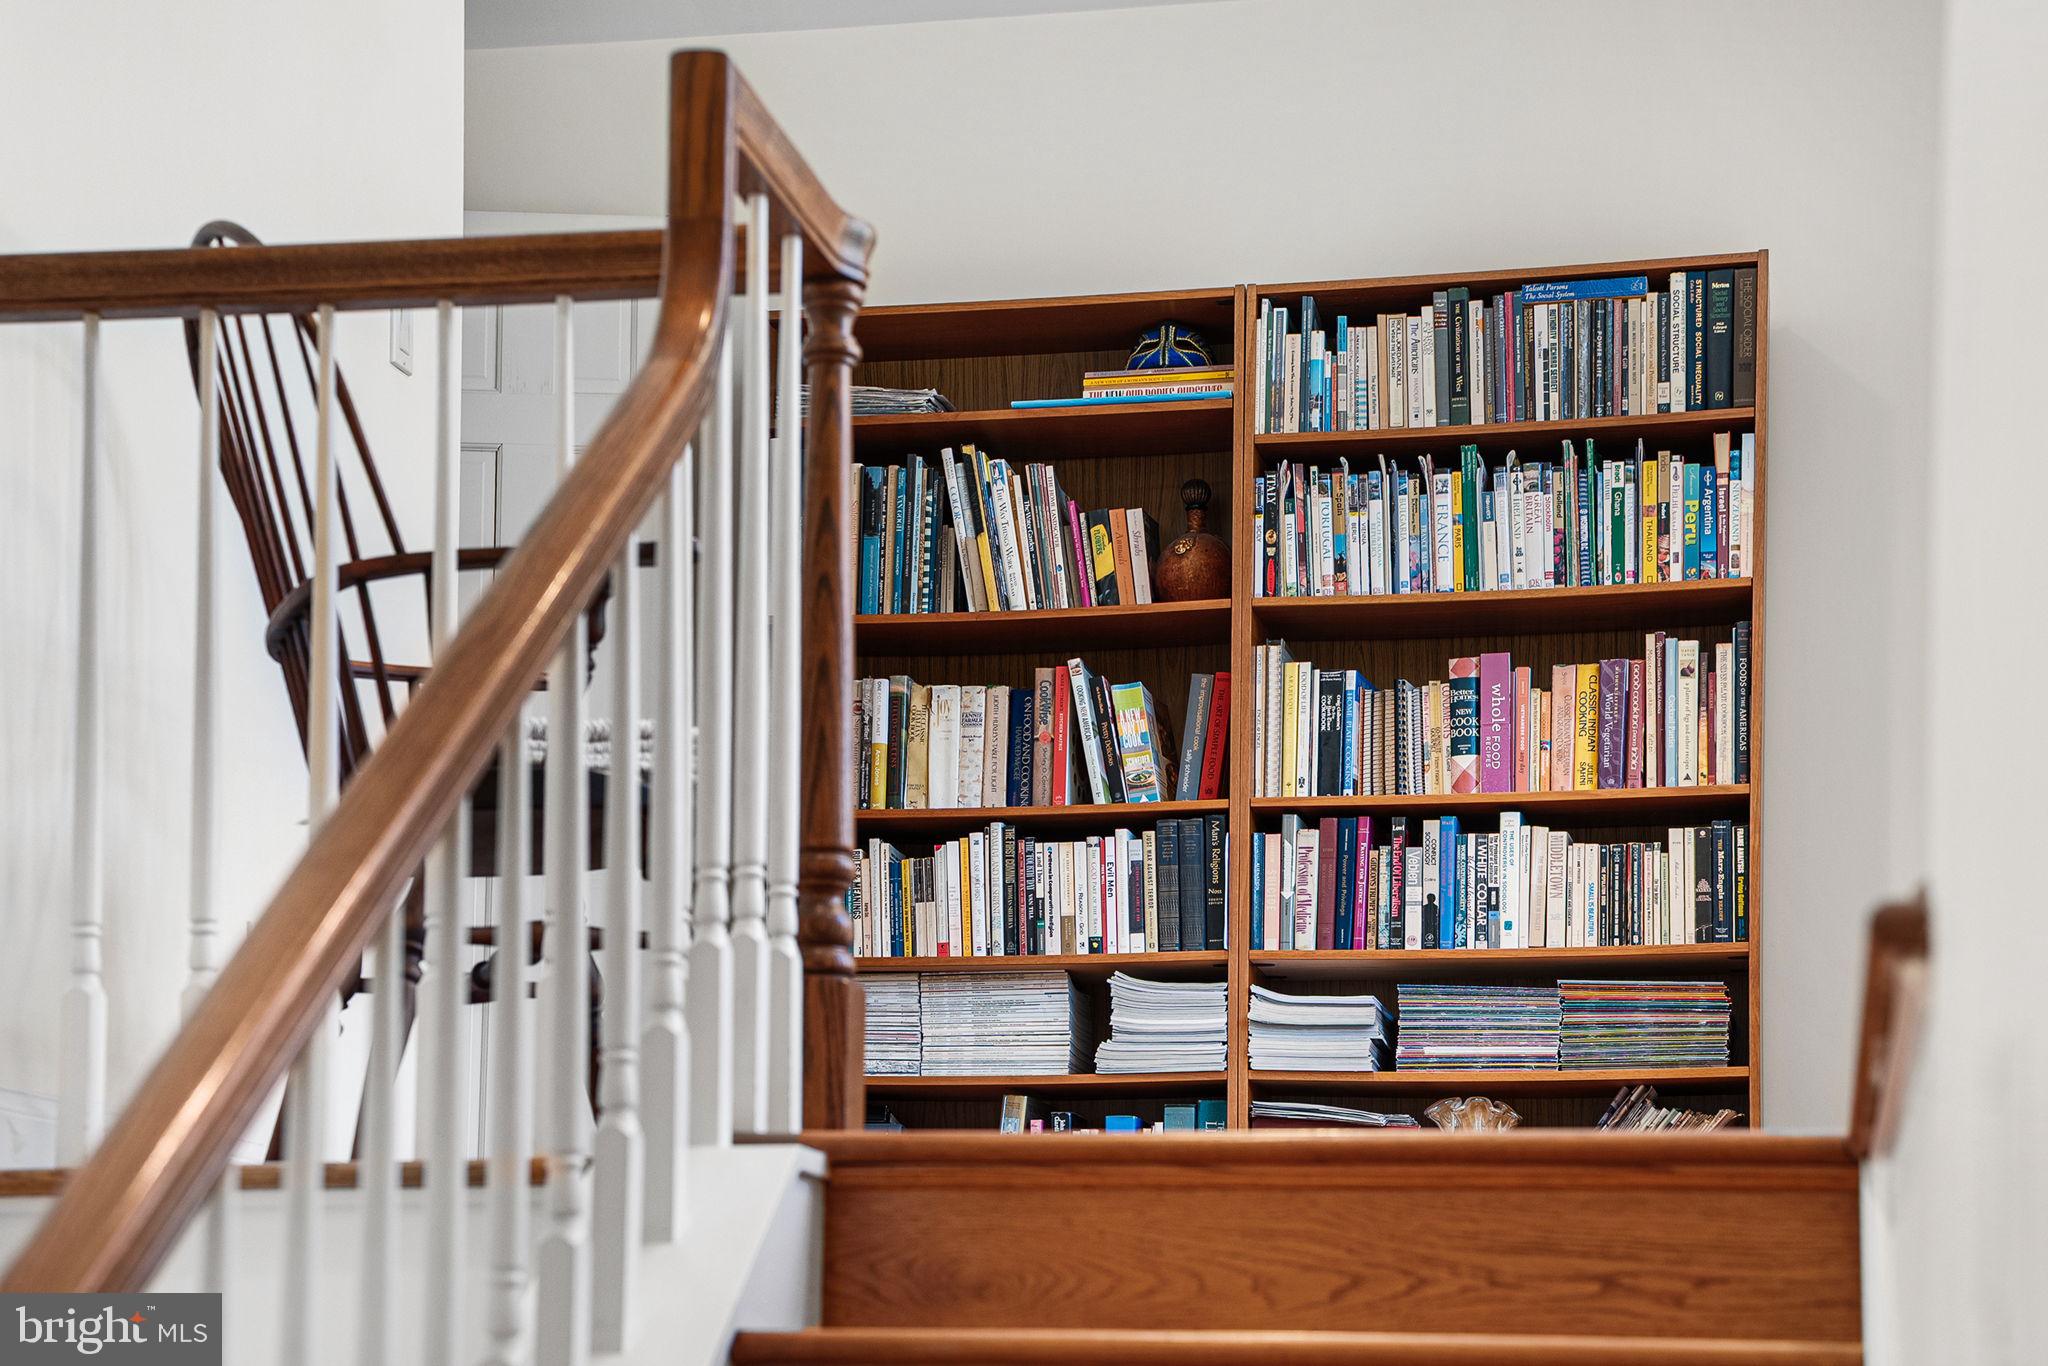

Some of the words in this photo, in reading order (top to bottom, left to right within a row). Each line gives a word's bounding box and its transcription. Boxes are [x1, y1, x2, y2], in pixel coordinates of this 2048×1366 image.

[1524, 292, 1536, 300] The
[1538, 291, 1554, 299] Social
[1556, 290, 1575, 299] System
[1525, 284, 1546, 293] Talcott
[1546, 283, 1568, 292] Parsons
[1744, 277, 1752, 293] THE
[1744, 295, 1752, 326] SOCIAL
[1410, 323, 1419, 336] The
[1411, 338, 1420, 374] Americans
[1744, 329, 1752, 358] ORDER
[1660, 455, 1668, 472] India
[896, 495, 904, 510] VAN
[996, 487, 1005, 501] THE
[1266, 474, 1276, 505] ITALY
[950, 486, 961, 520] COLOR
[998, 504, 1008, 519] WAY
[1335, 493, 1344, 516] Spain
[1526, 496, 1534, 534] BRITAIN
[1534, 494, 1542, 525] GREAT
[1615, 492, 1623, 516] Ghana
[1703, 488, 1714, 535] Argentina
[1051, 509, 1060, 548] LANDSCAPER
[1321, 501, 1332, 562] PORTUGAL
[1513, 498, 1522, 539] IRELAND
[1684, 500, 1700, 545] Peru
[1001, 520, 1010, 546] THINGS
[1026, 530, 1035, 552] Garden
[1132, 530, 1143, 556] Shrubs
[1437, 504, 1449, 562] FRANCE
[1004, 547, 1013, 570] WORK
[1116, 532, 1127, 565] Annuals
[1024, 697, 1032, 713] ON
[1039, 680, 1053, 726] CookWise
[1076, 685, 1087, 706] COOKING
[1301, 691, 1306, 699] OF
[1588, 675, 1597, 716] CLASSIC
[1741, 688, 1746, 696] OF
[1080, 706, 1088, 716] NEW
[1195, 690, 1207, 735] improvisational
[1442, 686, 1450, 739] CONDIMENTS
[1492, 683, 1506, 732] whole
[1579, 691, 1588, 737] COOKING
[1604, 693, 1614, 719] World
[1686, 704, 1691, 713] of
[1023, 715, 1032, 742] FOOD
[1082, 717, 1092, 741] AMERICAN
[1101, 722, 1110, 740] Pretty
[1214, 719, 1221, 729] OF
[1450, 717, 1479, 727] COOK
[1450, 728, 1479, 738] BOOK
[1588, 718, 1597, 752] INDIAN
[1022, 743, 1031, 764] AND
[1105, 740, 1114, 766] Delicious
[1184, 749, 1193, 762] sally
[1193, 736, 1201, 751] cook
[1211, 730, 1220, 756] SIMPLE
[1492, 736, 1501, 769] FOOD
[1602, 723, 1613, 768] Vegetarian
[1182, 764, 1192, 793] schneider
[1208, 757, 1216, 780] FOOD
[1020, 766, 1030, 807] COOKING
[1211, 821, 1220, 846] Man's
[1393, 836, 1403, 850] The
[1026, 841, 1034, 853] THE
[1393, 850, 1402, 865] End
[1026, 854, 1034, 878] FOURTH
[1210, 849, 1221, 884] Religions
[1298, 846, 1314, 886] Profession
[1341, 854, 1349, 874] Power
[1392, 866, 1402, 875] Of
[1407, 851, 1420, 885] Veblen
[1477, 845, 1487, 879] WHITE
[1550, 835, 1564, 899] MIDDLETOWN
[1737, 848, 1745, 874] ANALYSIS
[1026, 879, 1034, 890] DAY
[1298, 889, 1311, 898] of
[1392, 876, 1402, 917] Liberalism
[1296, 899, 1312, 934] Medicine
[1477, 883, 1487, 926] COLLAR
